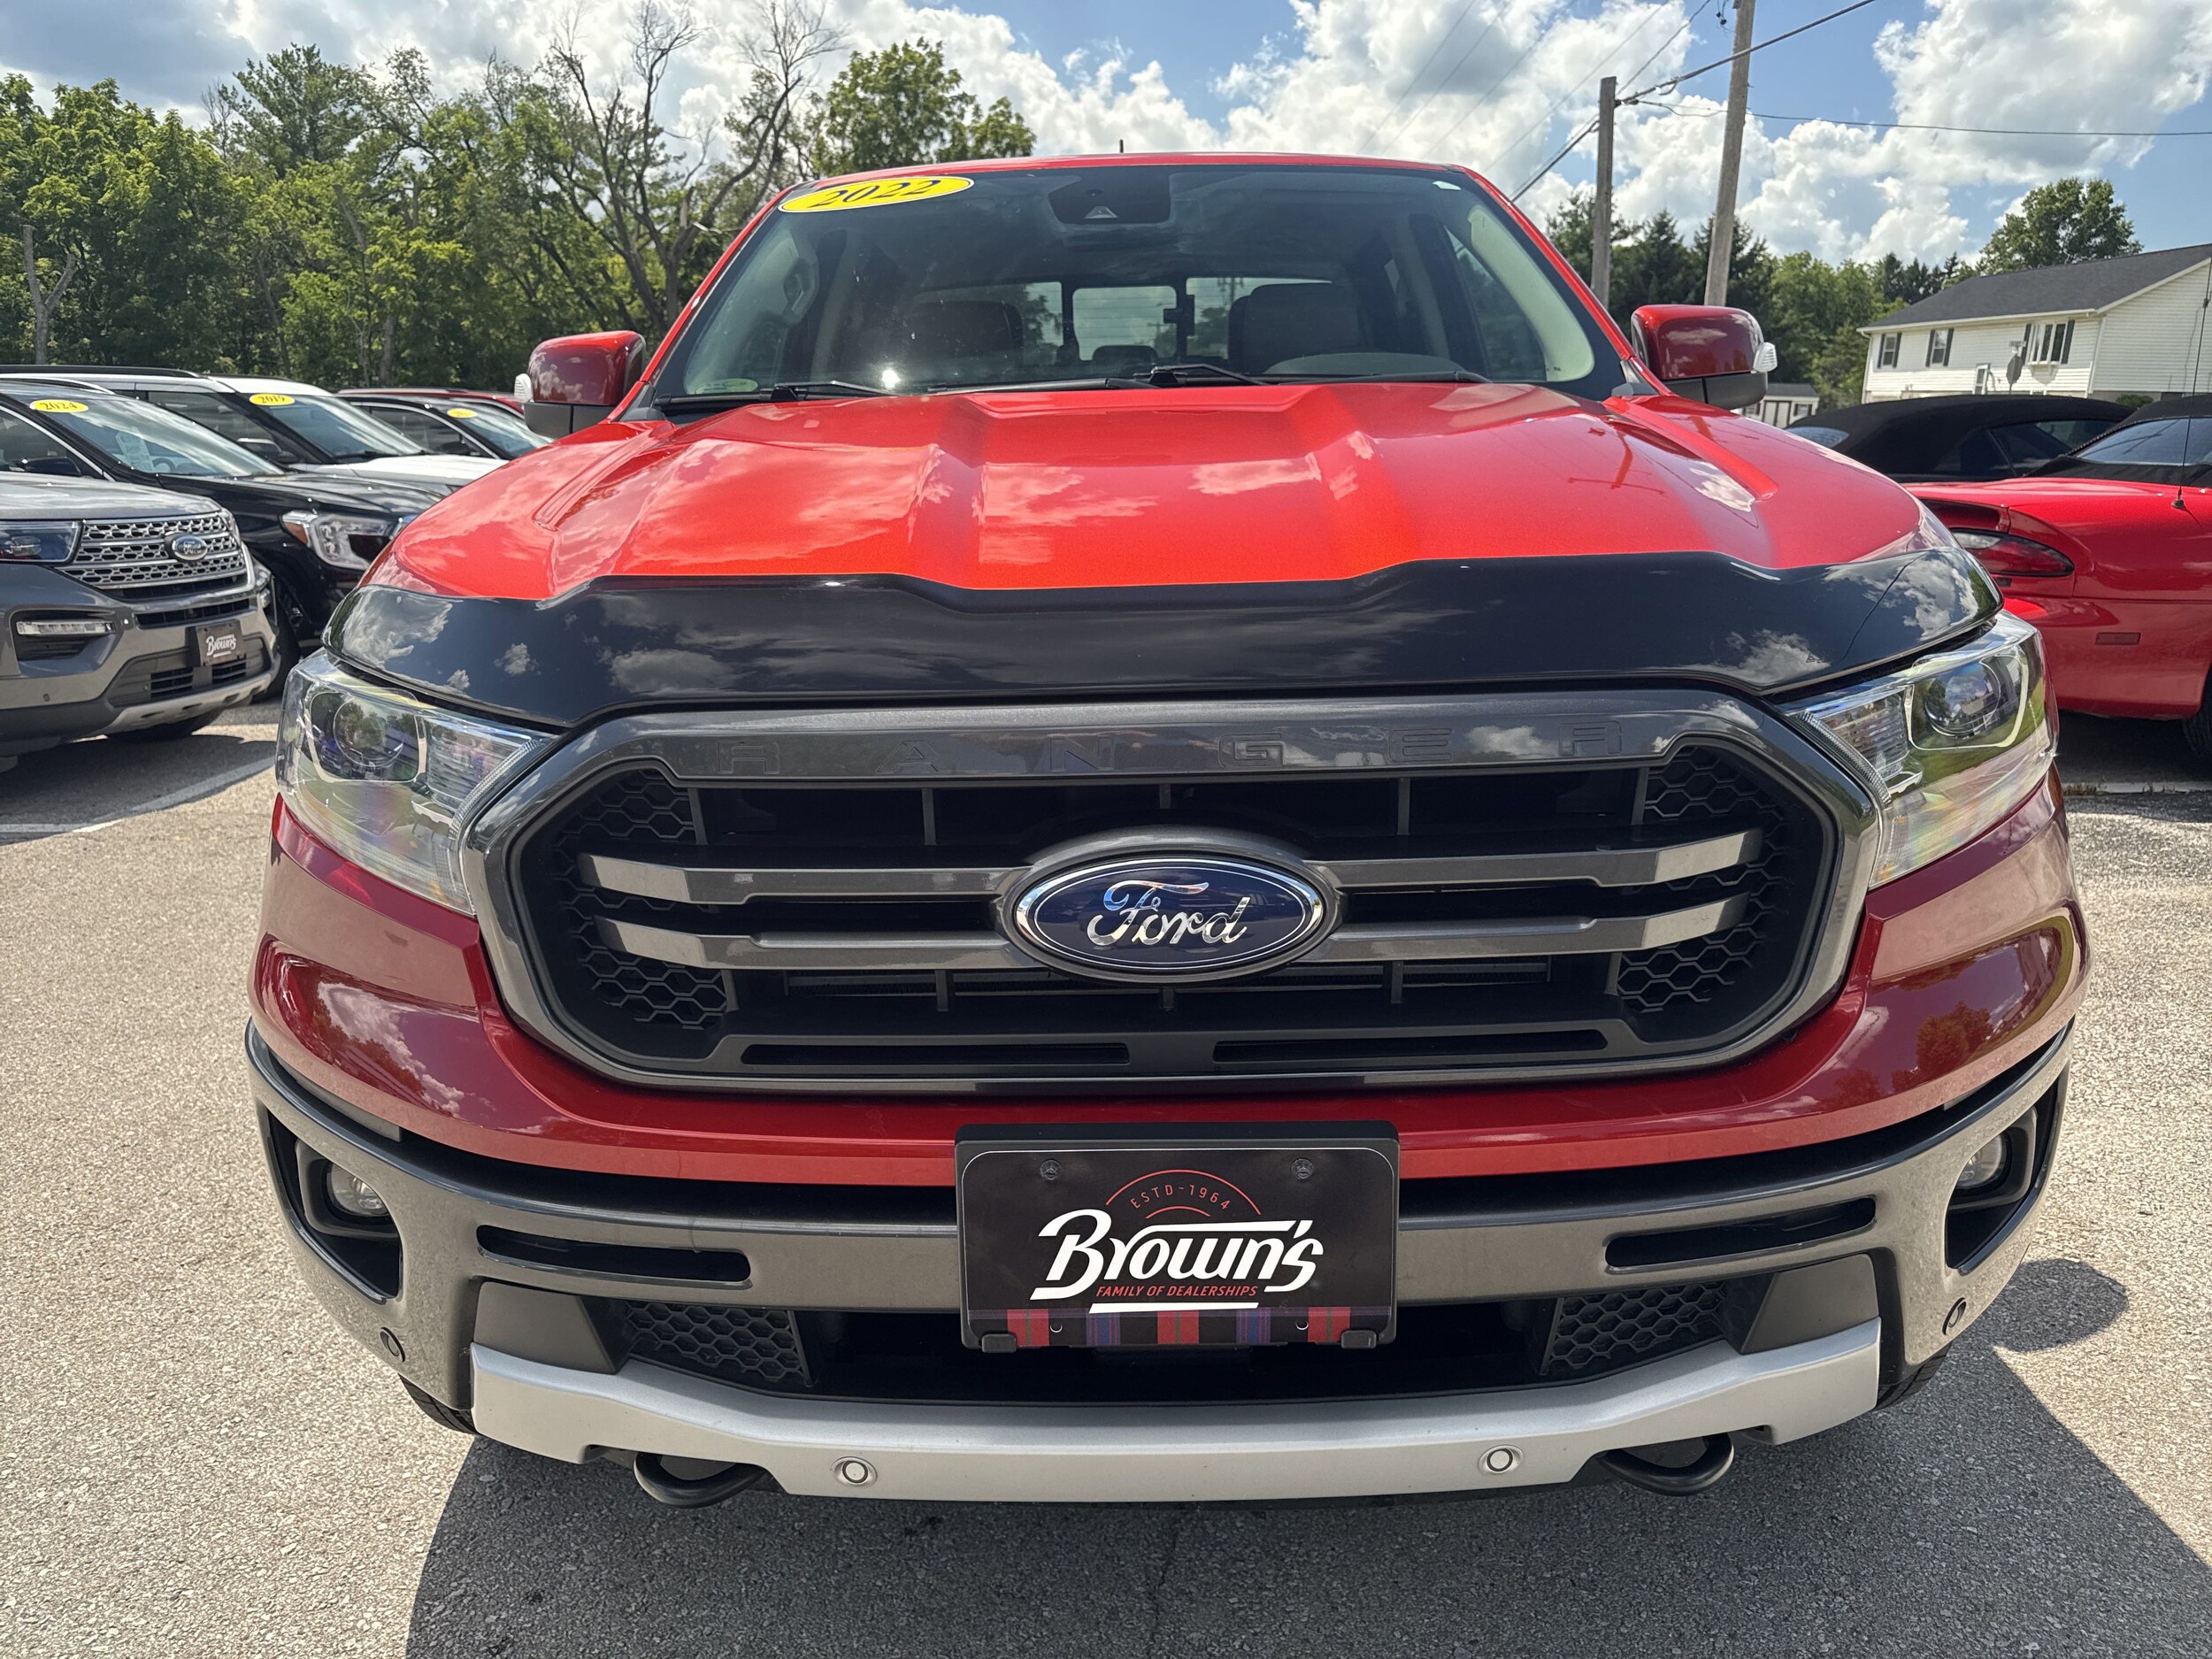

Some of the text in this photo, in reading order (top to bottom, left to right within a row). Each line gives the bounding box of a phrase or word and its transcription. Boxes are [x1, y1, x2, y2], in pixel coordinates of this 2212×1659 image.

[807, 180, 941, 208] 2022
[716, 720, 1623, 775] RANGER
[1087, 879, 1251, 947] Ford
[1029, 1209, 1325, 1301] Brown's
[1095, 1286, 1259, 1297] FAMILY OF DEALERSHIPS
